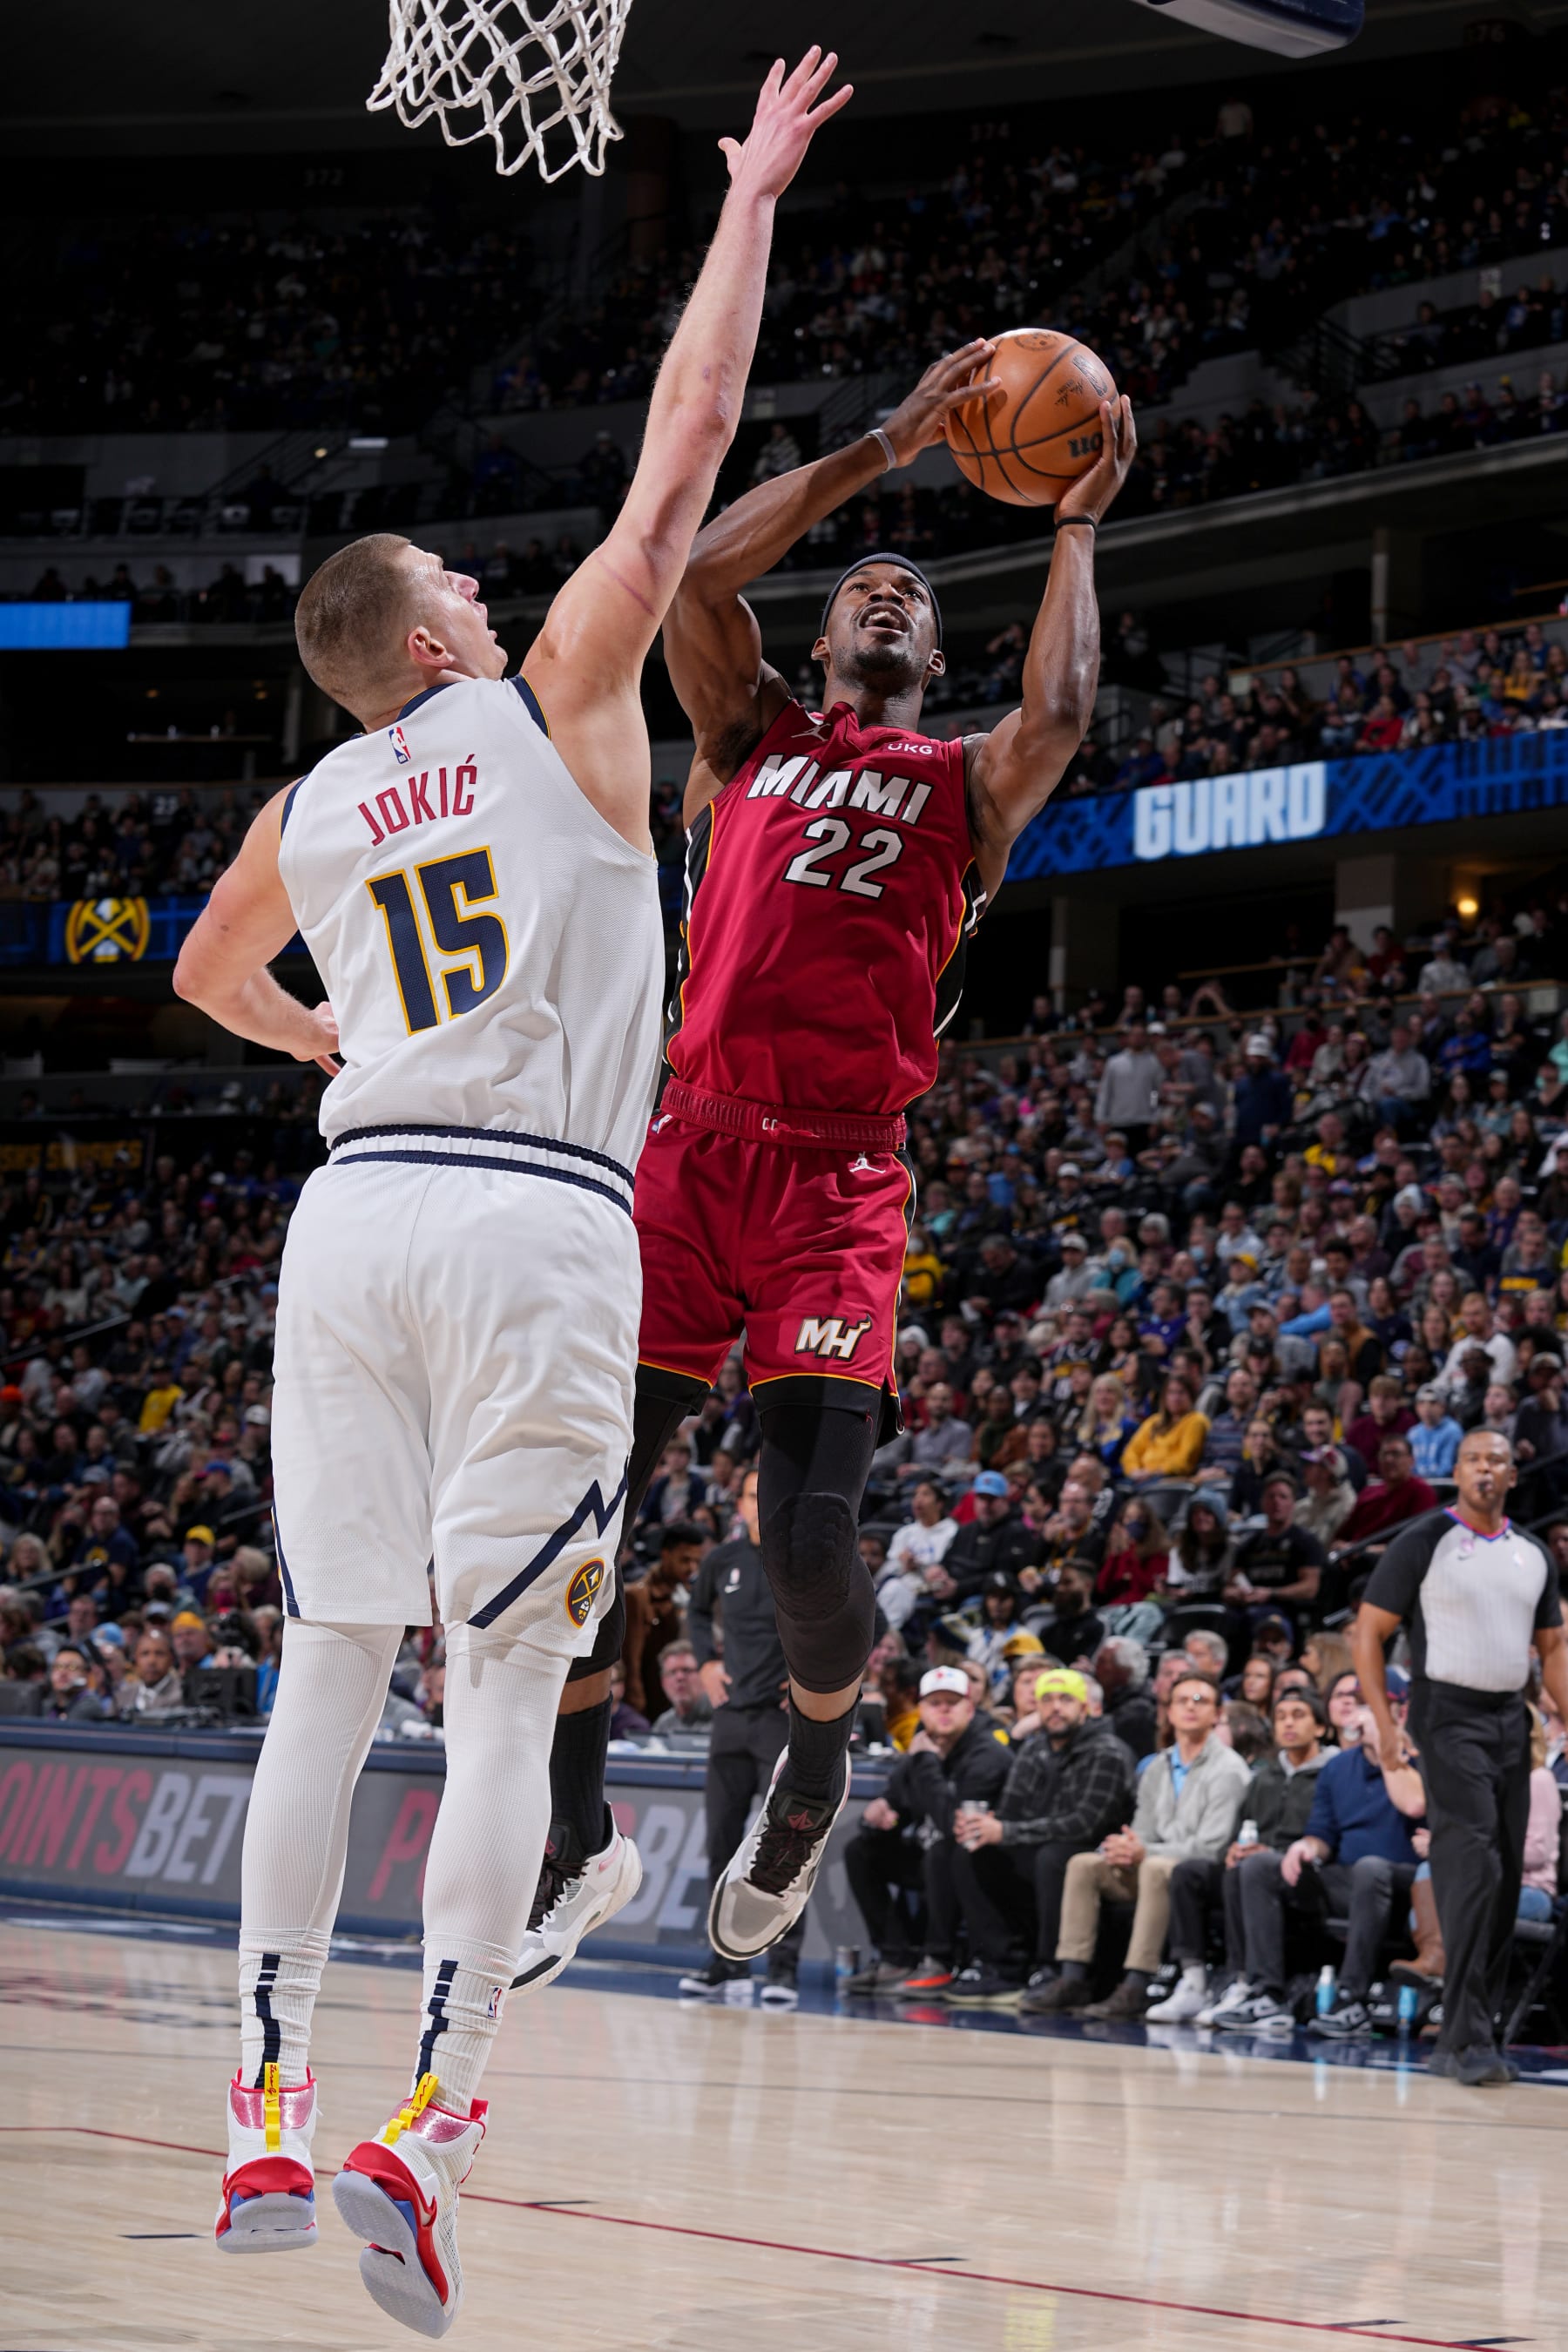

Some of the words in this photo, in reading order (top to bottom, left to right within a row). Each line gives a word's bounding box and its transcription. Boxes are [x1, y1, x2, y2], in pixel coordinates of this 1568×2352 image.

[358, 754, 477, 847] JOKIĆ
[746, 754, 933, 826] MIAMI
[1134, 760, 1327, 861] GUARD
[781, 816, 905, 900] 22
[365, 845, 510, 1037] 15
